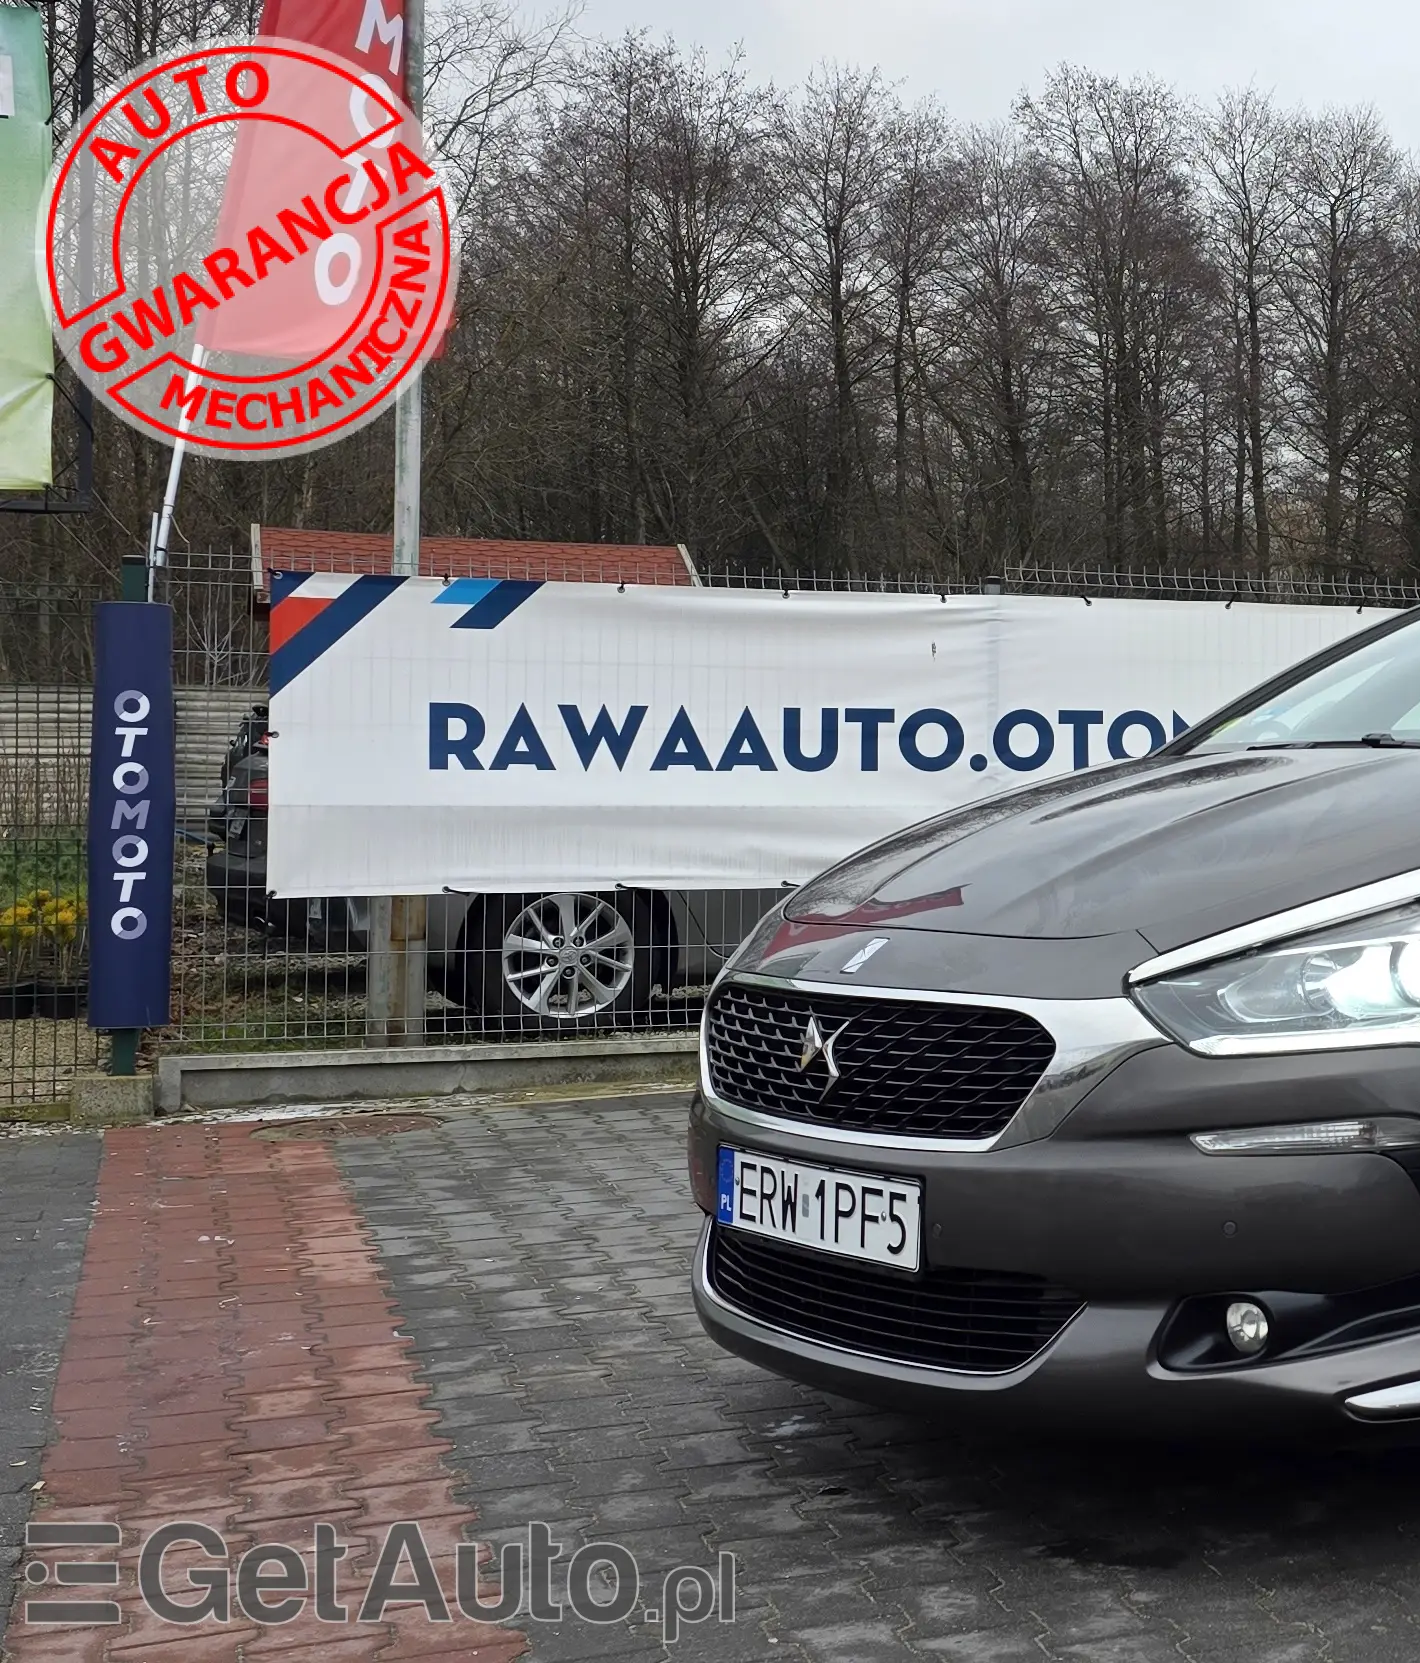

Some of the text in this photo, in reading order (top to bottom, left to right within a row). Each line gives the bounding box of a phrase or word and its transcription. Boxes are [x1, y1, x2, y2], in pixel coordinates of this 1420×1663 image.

[429, 702, 1191, 774] RAWAAUTO.OTO
[110, 689, 150, 940] OTOMOTO
[720, 1193, 732, 1212] PL
[739, 1160, 907, 1255] ERW 1PF5
